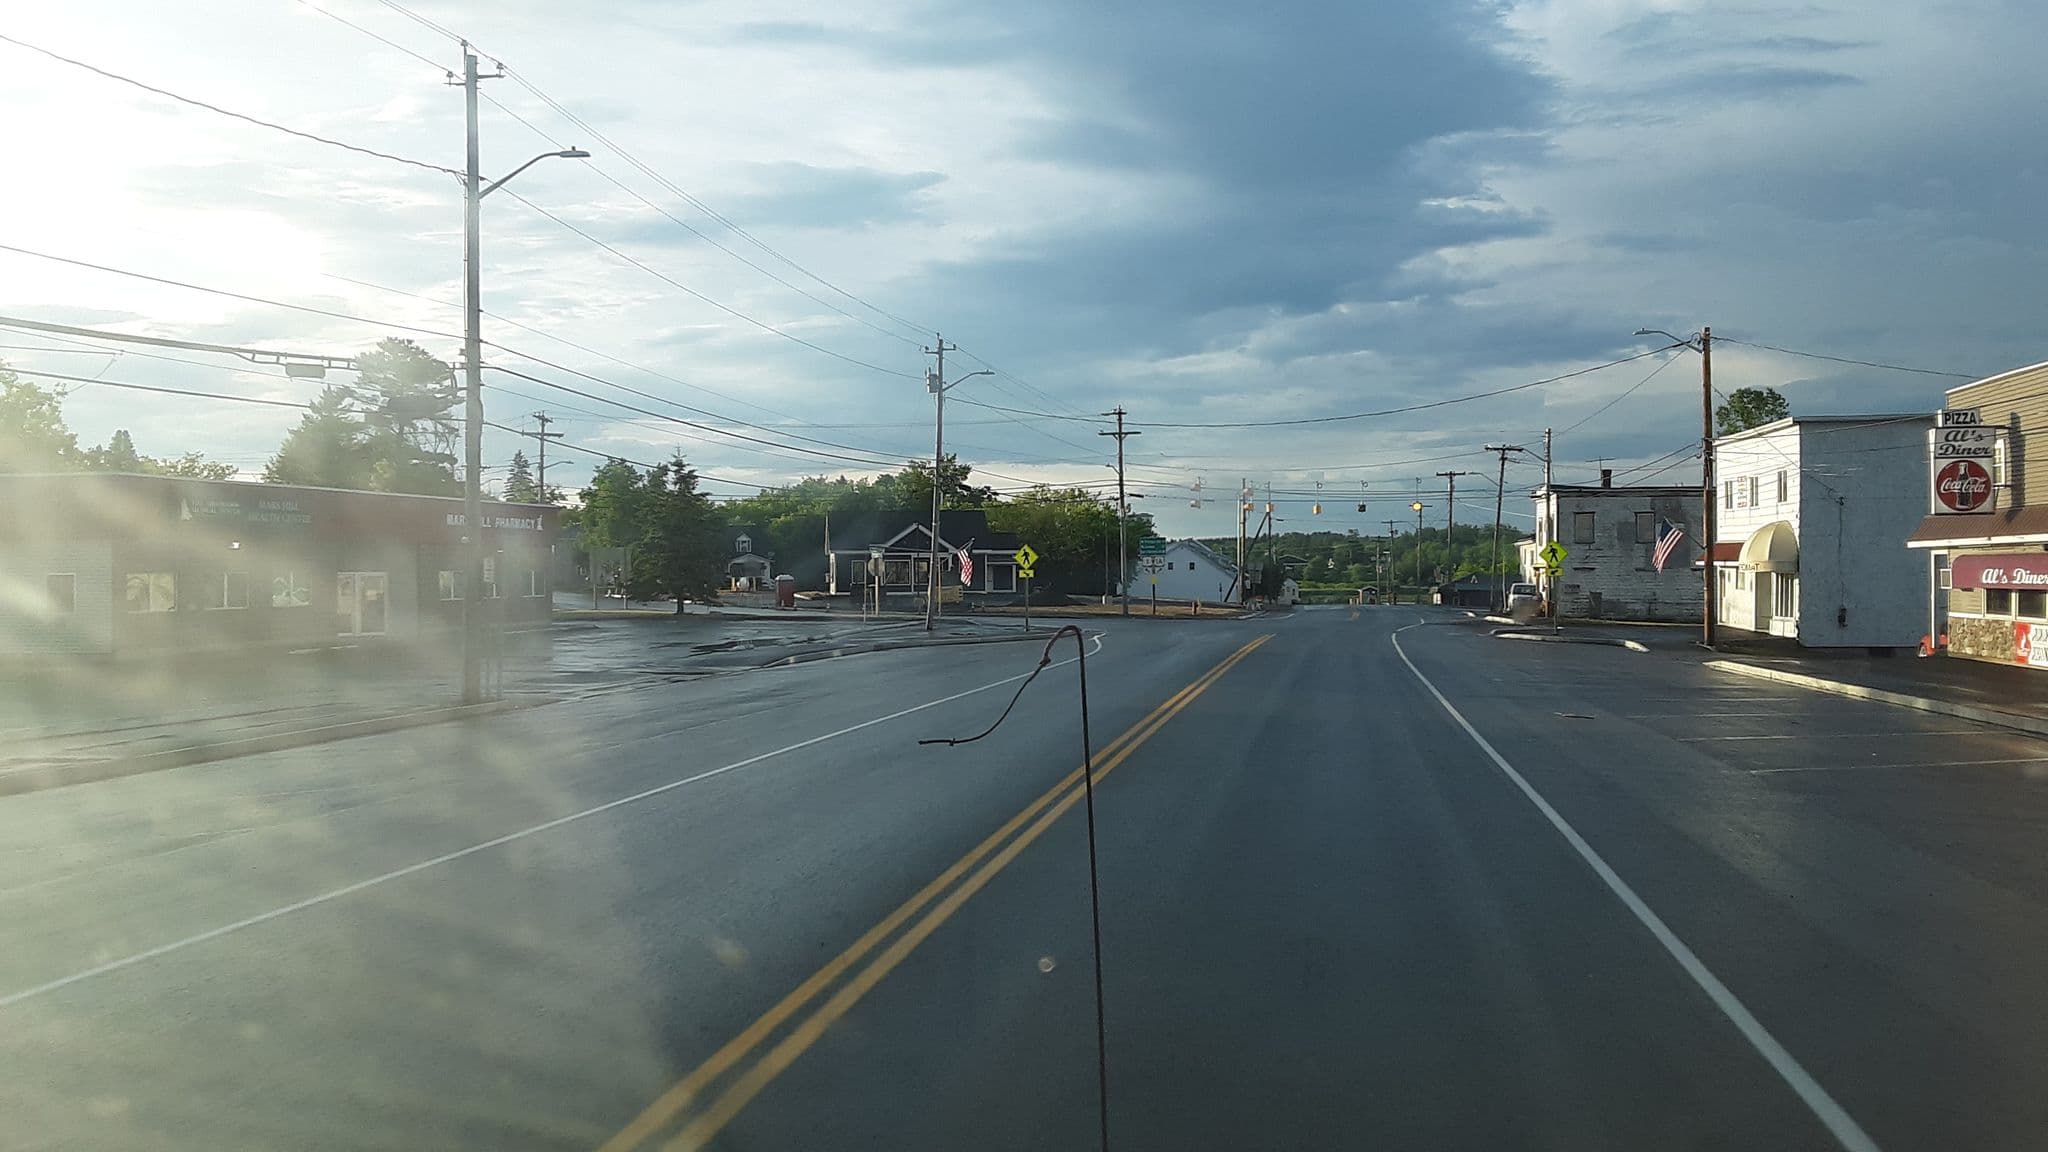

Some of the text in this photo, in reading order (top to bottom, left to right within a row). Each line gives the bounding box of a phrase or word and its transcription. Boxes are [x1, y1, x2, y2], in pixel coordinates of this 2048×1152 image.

[1944, 412, 1977, 425] PIZZA
[1944, 429, 1983, 442] Al's
[1938, 443, 1991, 455] Diner
[495, 517, 536, 529] PHARMACY
[1982, 568, 2008, 584] Al's
